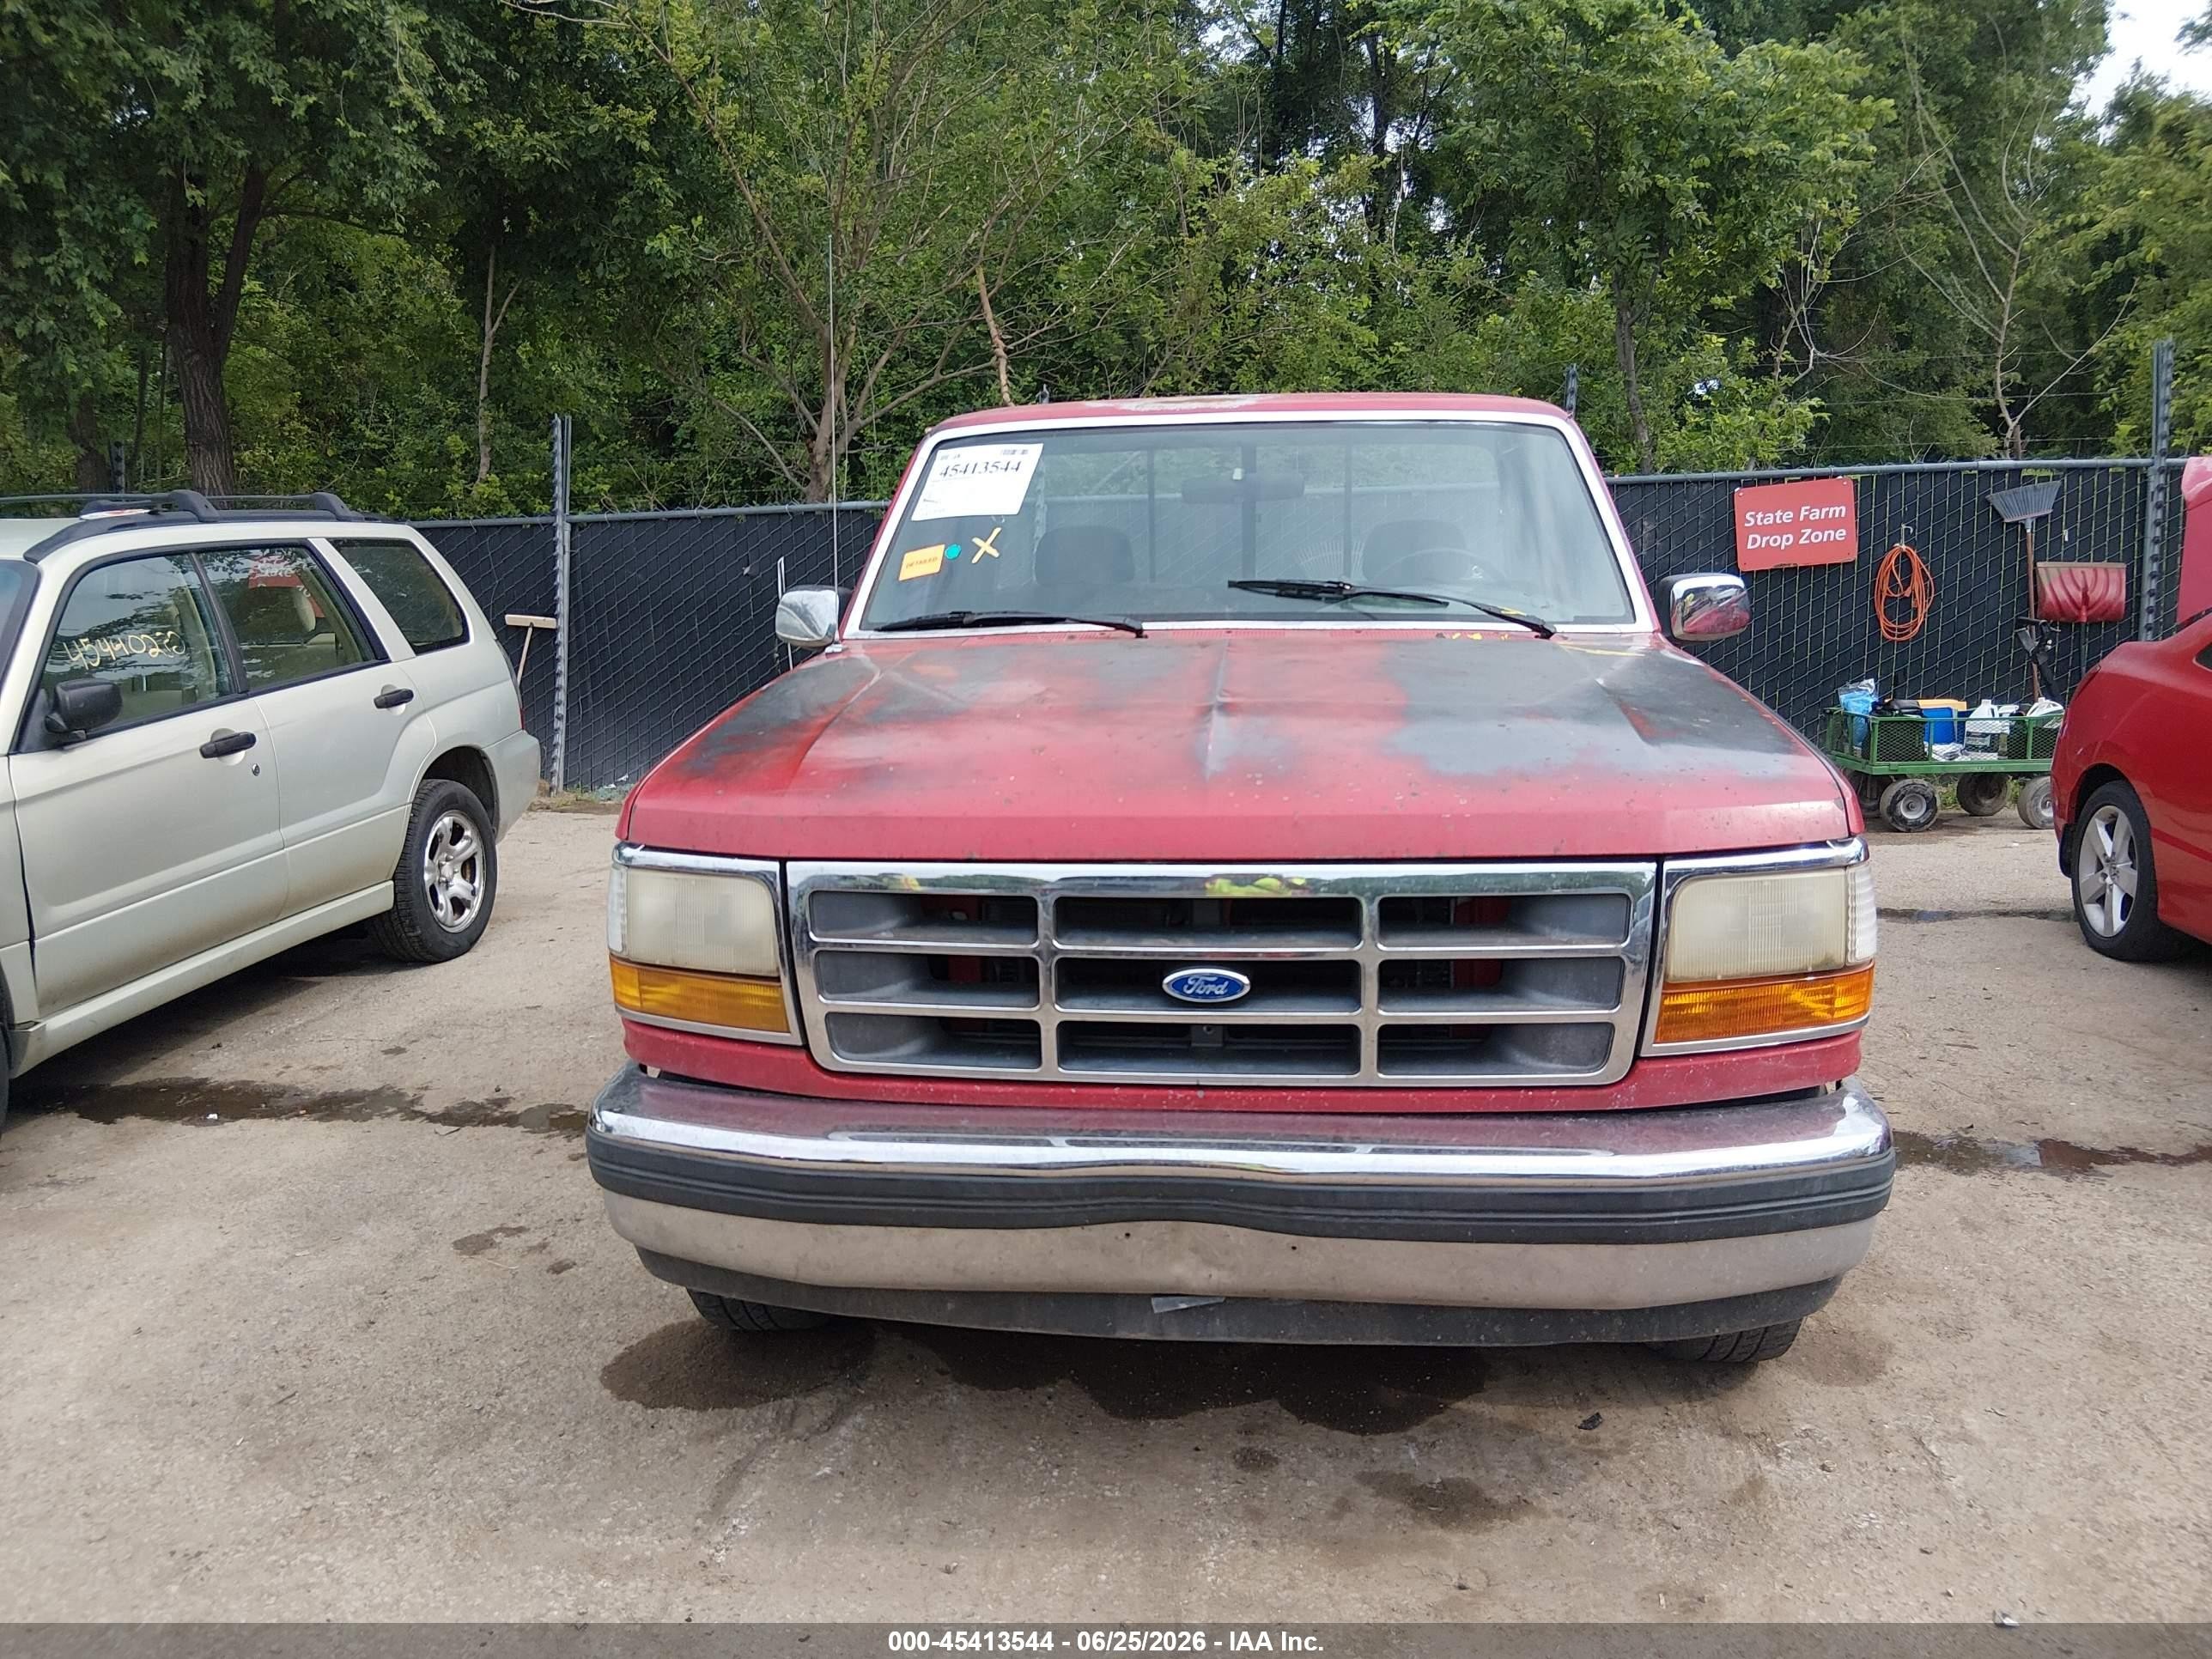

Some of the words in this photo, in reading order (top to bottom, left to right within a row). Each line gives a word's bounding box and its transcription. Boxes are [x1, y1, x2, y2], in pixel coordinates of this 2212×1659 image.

[939, 460, 1022, 477] 45413544
[1744, 508, 1794, 527] State
[1799, 505, 1846, 521] Farm
[1747, 533, 1794, 550] Drop
[1799, 528, 1846, 544] Zone
[1182, 975, 1230, 995] Ford
